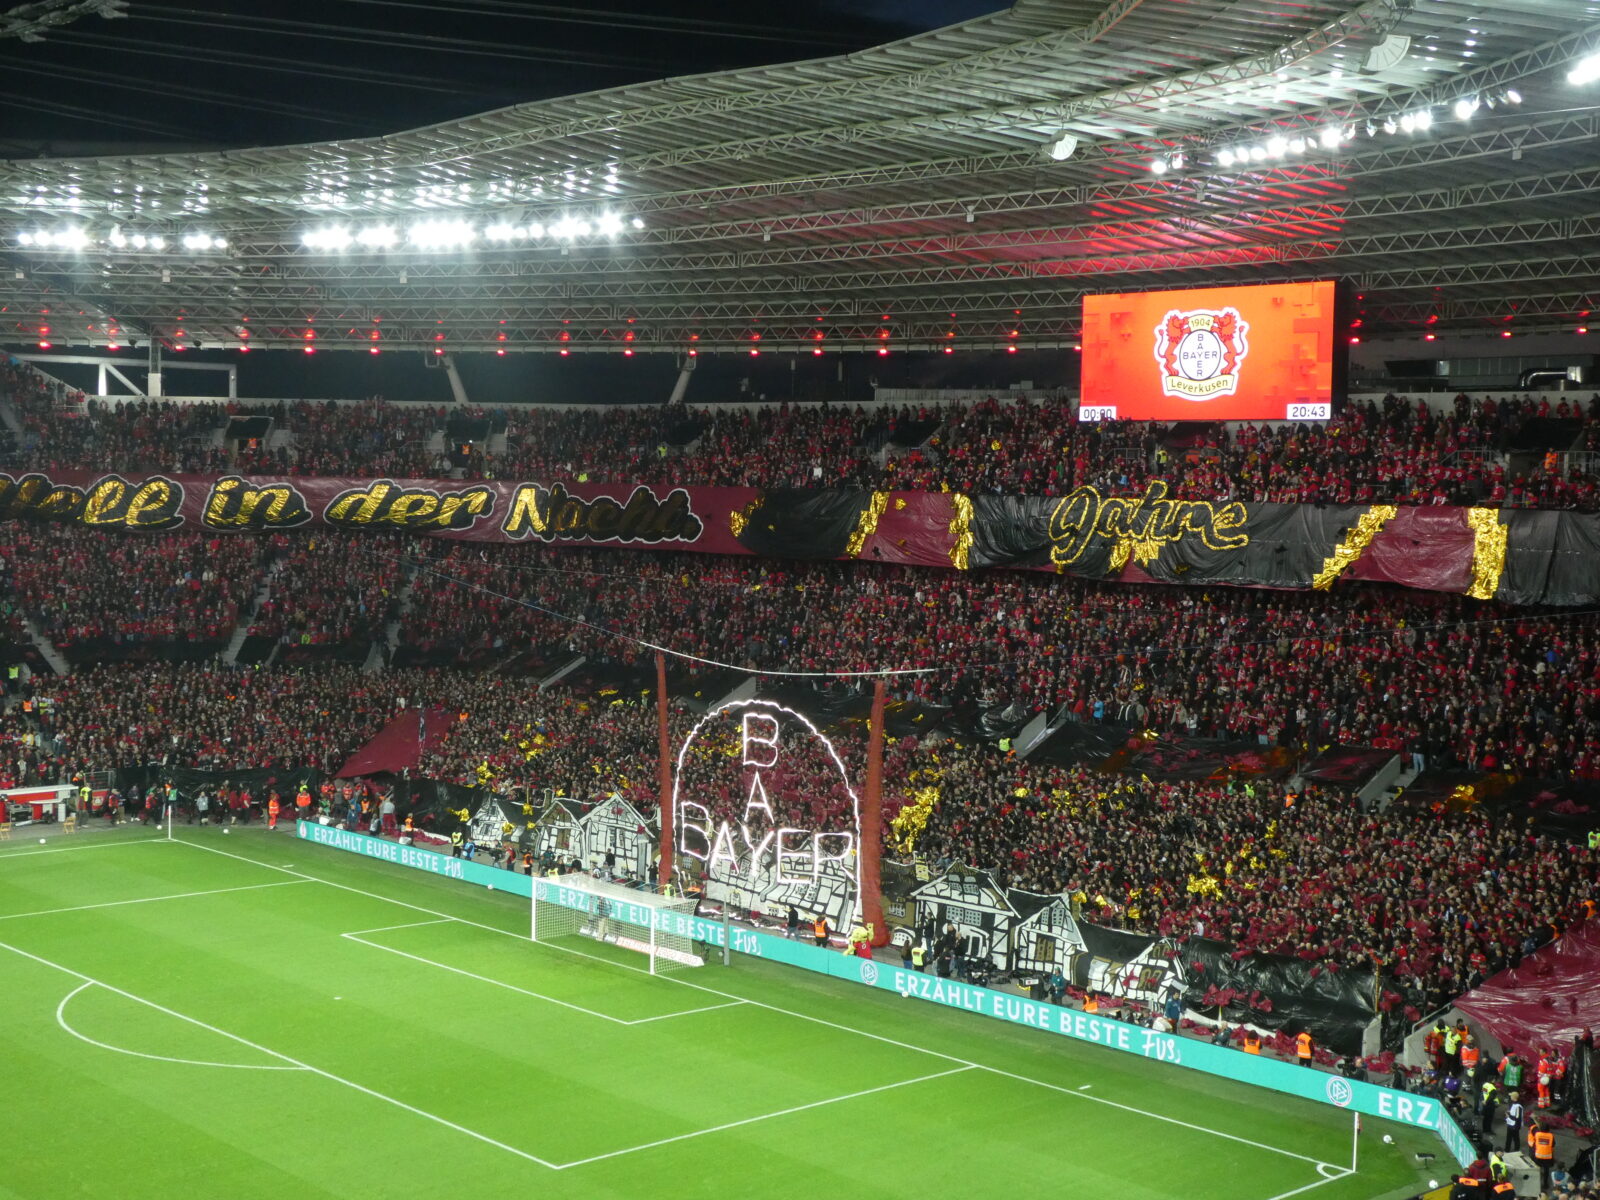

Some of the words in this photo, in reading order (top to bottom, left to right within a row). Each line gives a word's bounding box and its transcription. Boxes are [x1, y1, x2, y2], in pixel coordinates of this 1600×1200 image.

[1191, 318, 1211, 327] 1904
[1182, 351, 1218, 360] BAYER
[1171, 379, 1229, 393] Leverkusen
[1292, 406, 1326, 418] 20:43
[206, 480, 300, 525] in
[328, 484, 489, 527] der
[314, 827, 363, 852] ERZÄHLT
[366, 840, 397, 862] EURE
[401, 850, 438, 872] BESTE
[680, 800, 857, 886] BAYER
[676, 917, 726, 944] BESTE
[895, 971, 985, 1011] ERZÄHLT
[993, 994, 1050, 1029] EURE
[1059, 1012, 1130, 1049] BESTE
